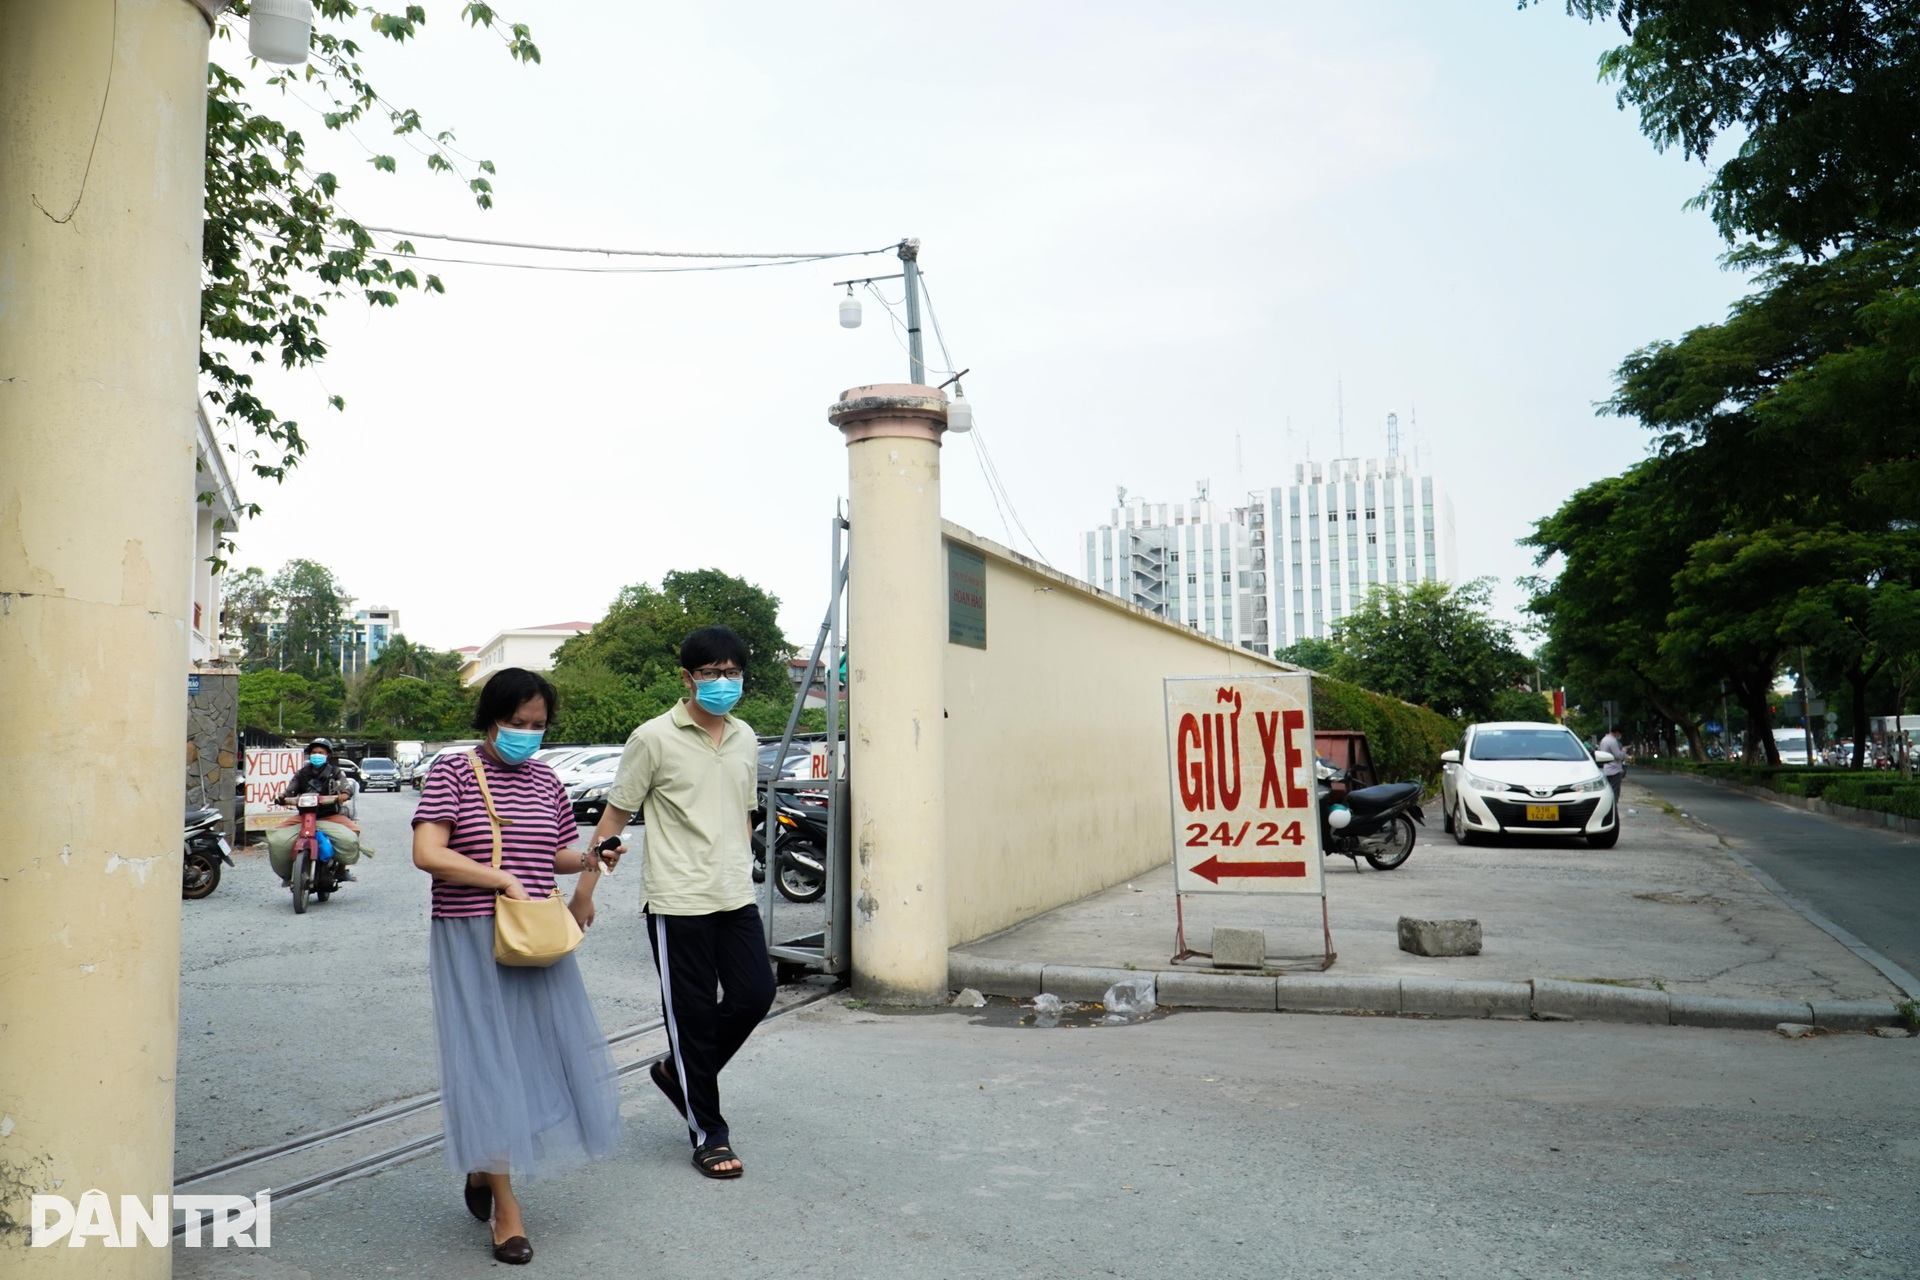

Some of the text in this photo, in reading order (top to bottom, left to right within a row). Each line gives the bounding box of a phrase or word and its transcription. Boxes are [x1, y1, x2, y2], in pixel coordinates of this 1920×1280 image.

[1177, 686, 1308, 812] GIỮ XE
[246, 750, 278, 776] YÊU
[1185, 821, 1306, 847] 24/24
